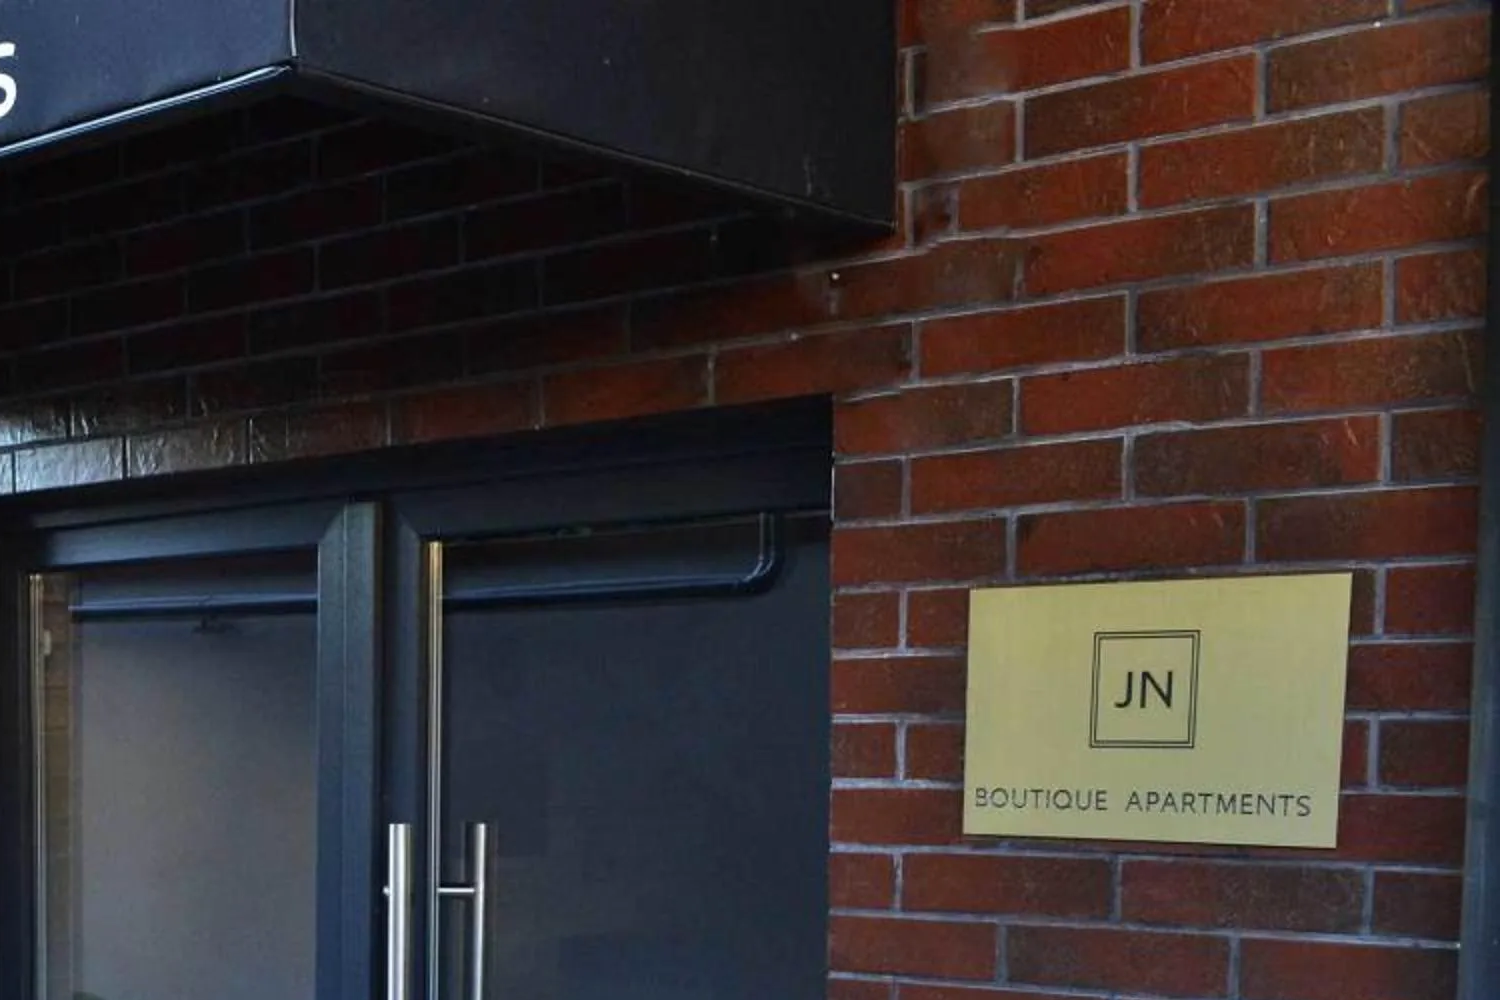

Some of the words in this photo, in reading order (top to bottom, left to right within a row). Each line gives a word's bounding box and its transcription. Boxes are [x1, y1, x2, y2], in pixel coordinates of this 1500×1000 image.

[1113, 670, 1175, 709] JN
[974, 786, 1109, 812] BOUTIQUE
[1124, 790, 1312, 818] APARTMENTS
